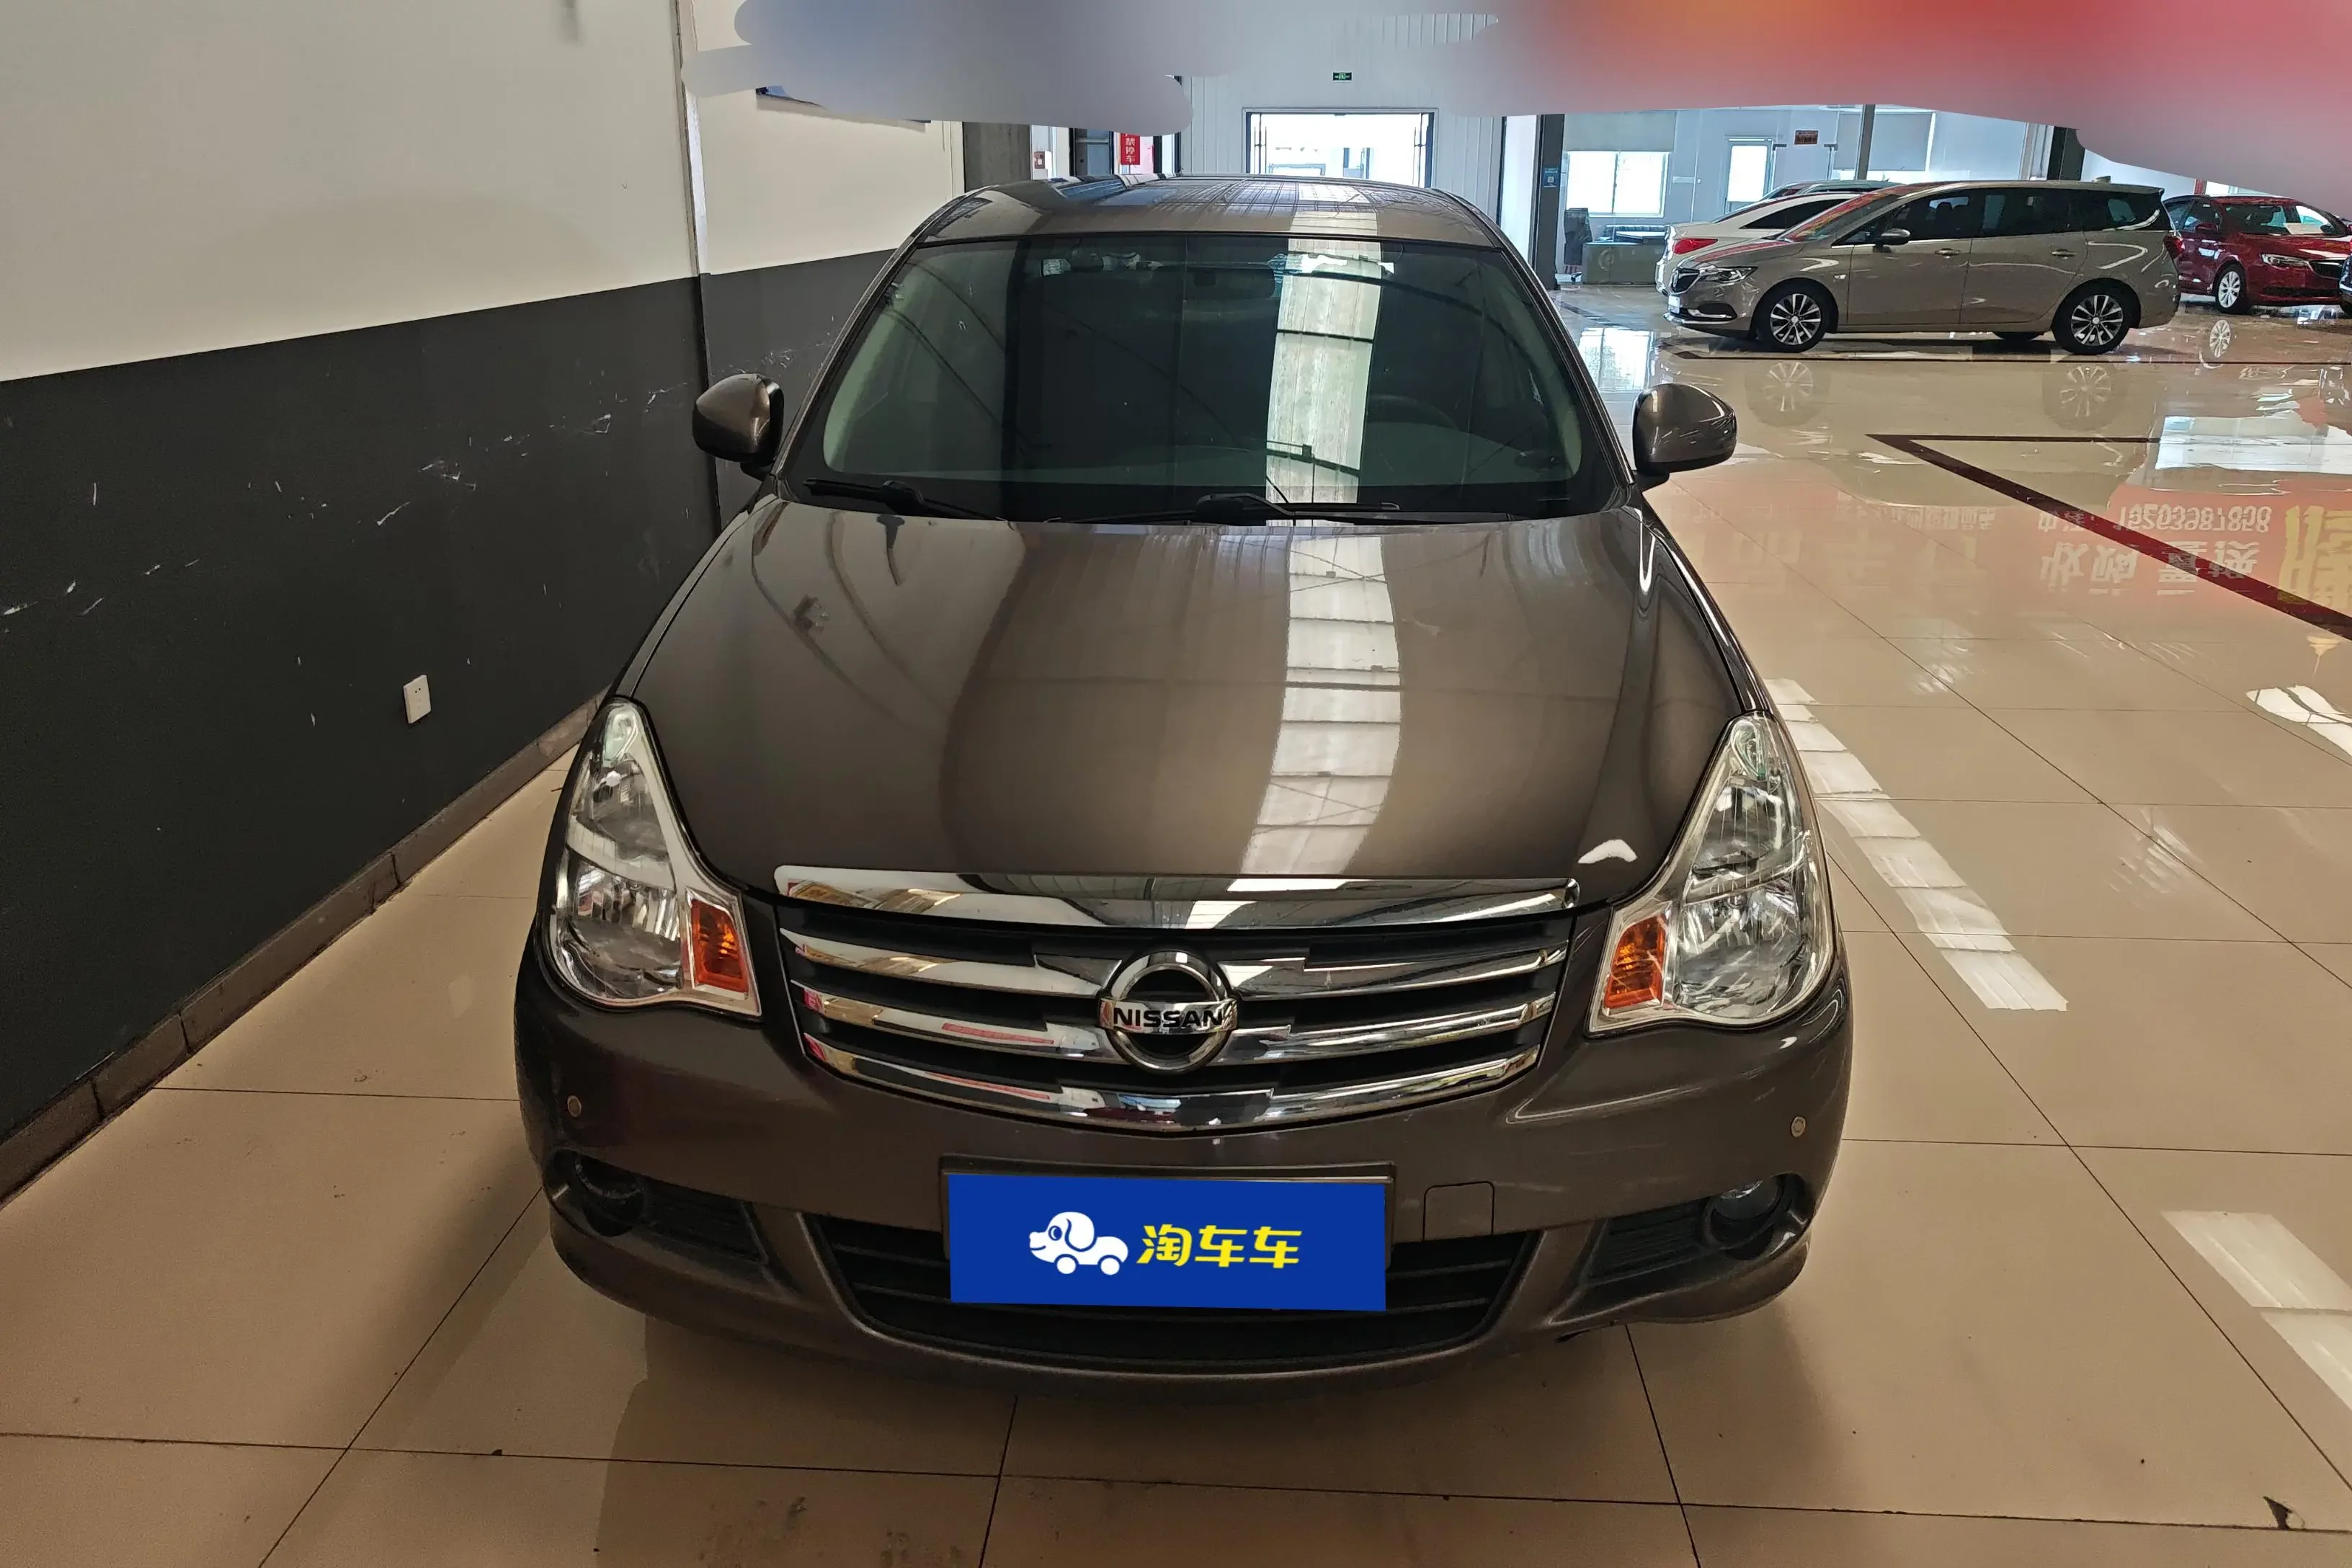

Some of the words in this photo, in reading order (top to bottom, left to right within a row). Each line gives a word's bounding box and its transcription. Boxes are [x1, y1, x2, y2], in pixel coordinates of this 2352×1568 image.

[1125, 133, 1136, 164] 禁停车
[1113, 1007, 1223, 1028] NISSAN
